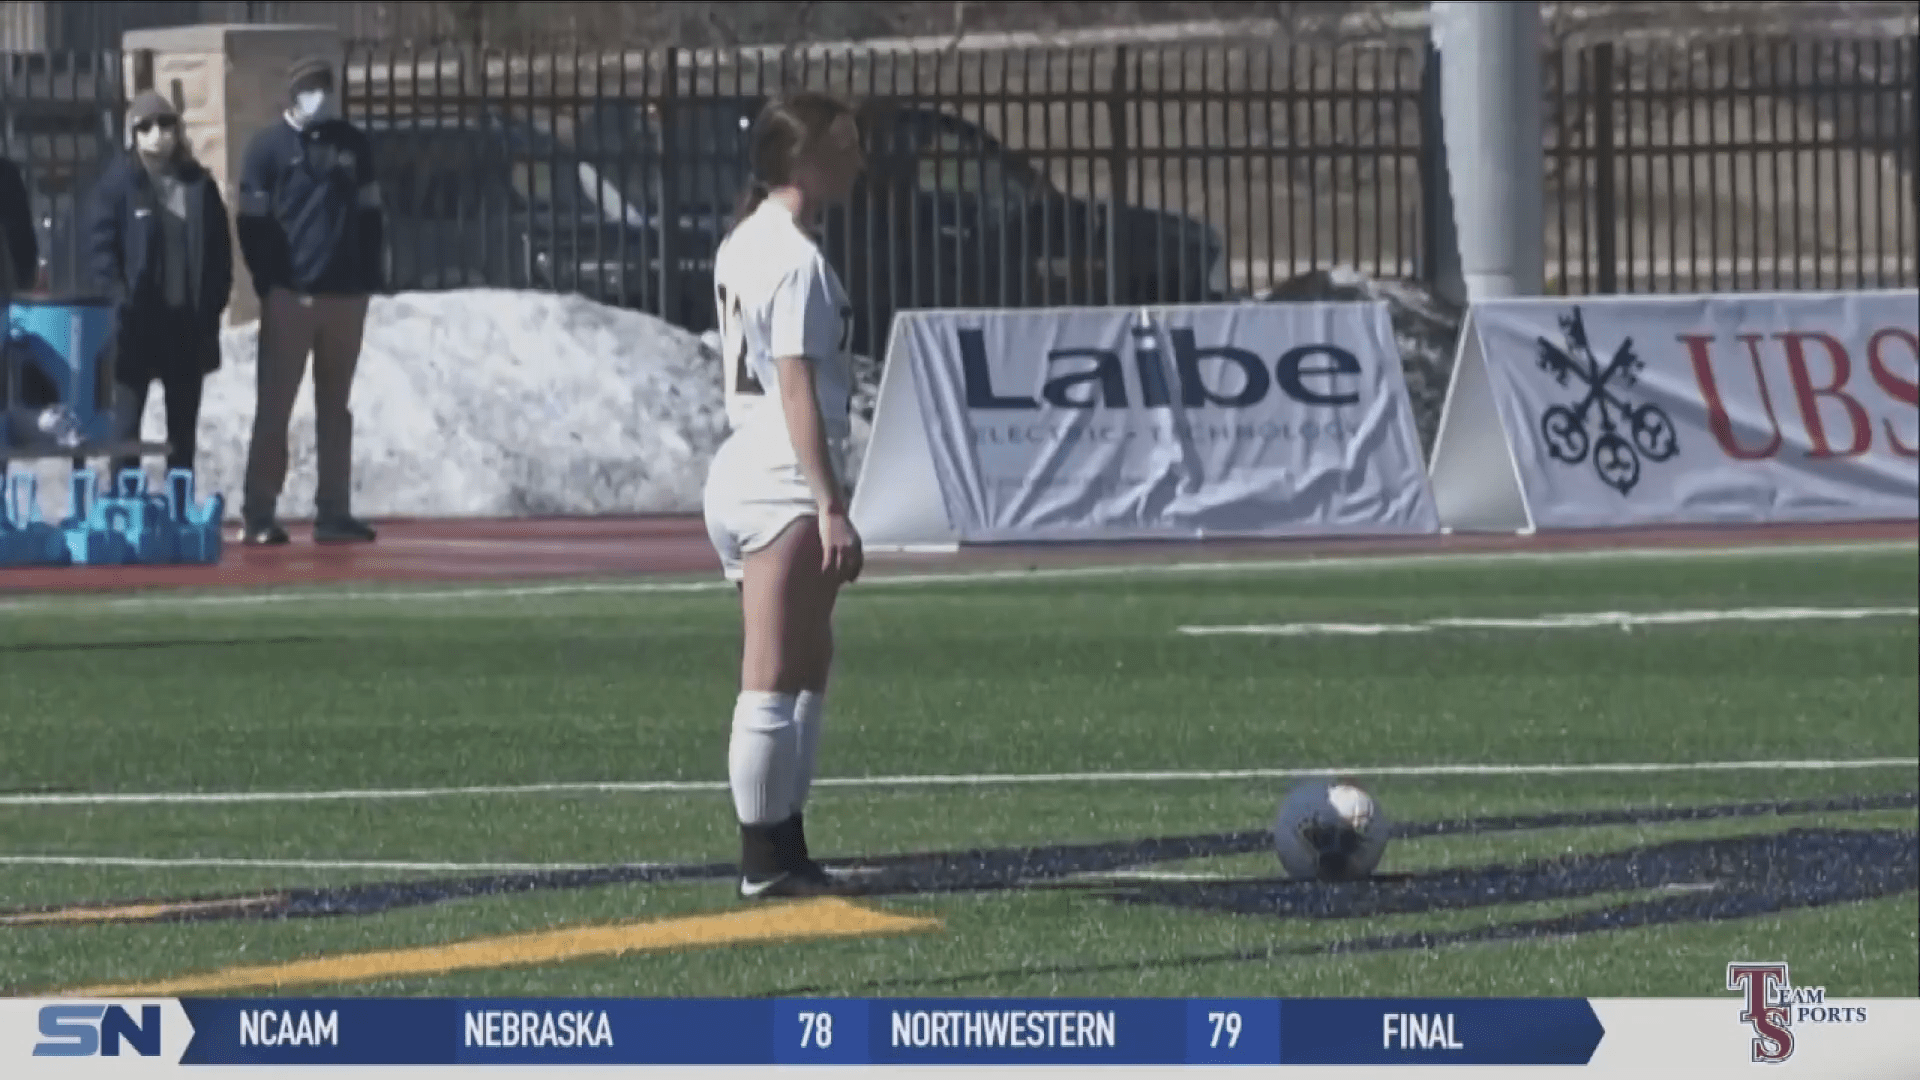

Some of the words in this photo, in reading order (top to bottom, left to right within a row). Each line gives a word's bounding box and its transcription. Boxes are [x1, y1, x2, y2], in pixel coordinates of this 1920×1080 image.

[957, 327, 1362, 408] Laibe
[1676, 327, 1919, 460] UBS
[975, 425, 1117, 445] ELECIC
[1150, 422, 1360, 443] TCHNOLOGY
